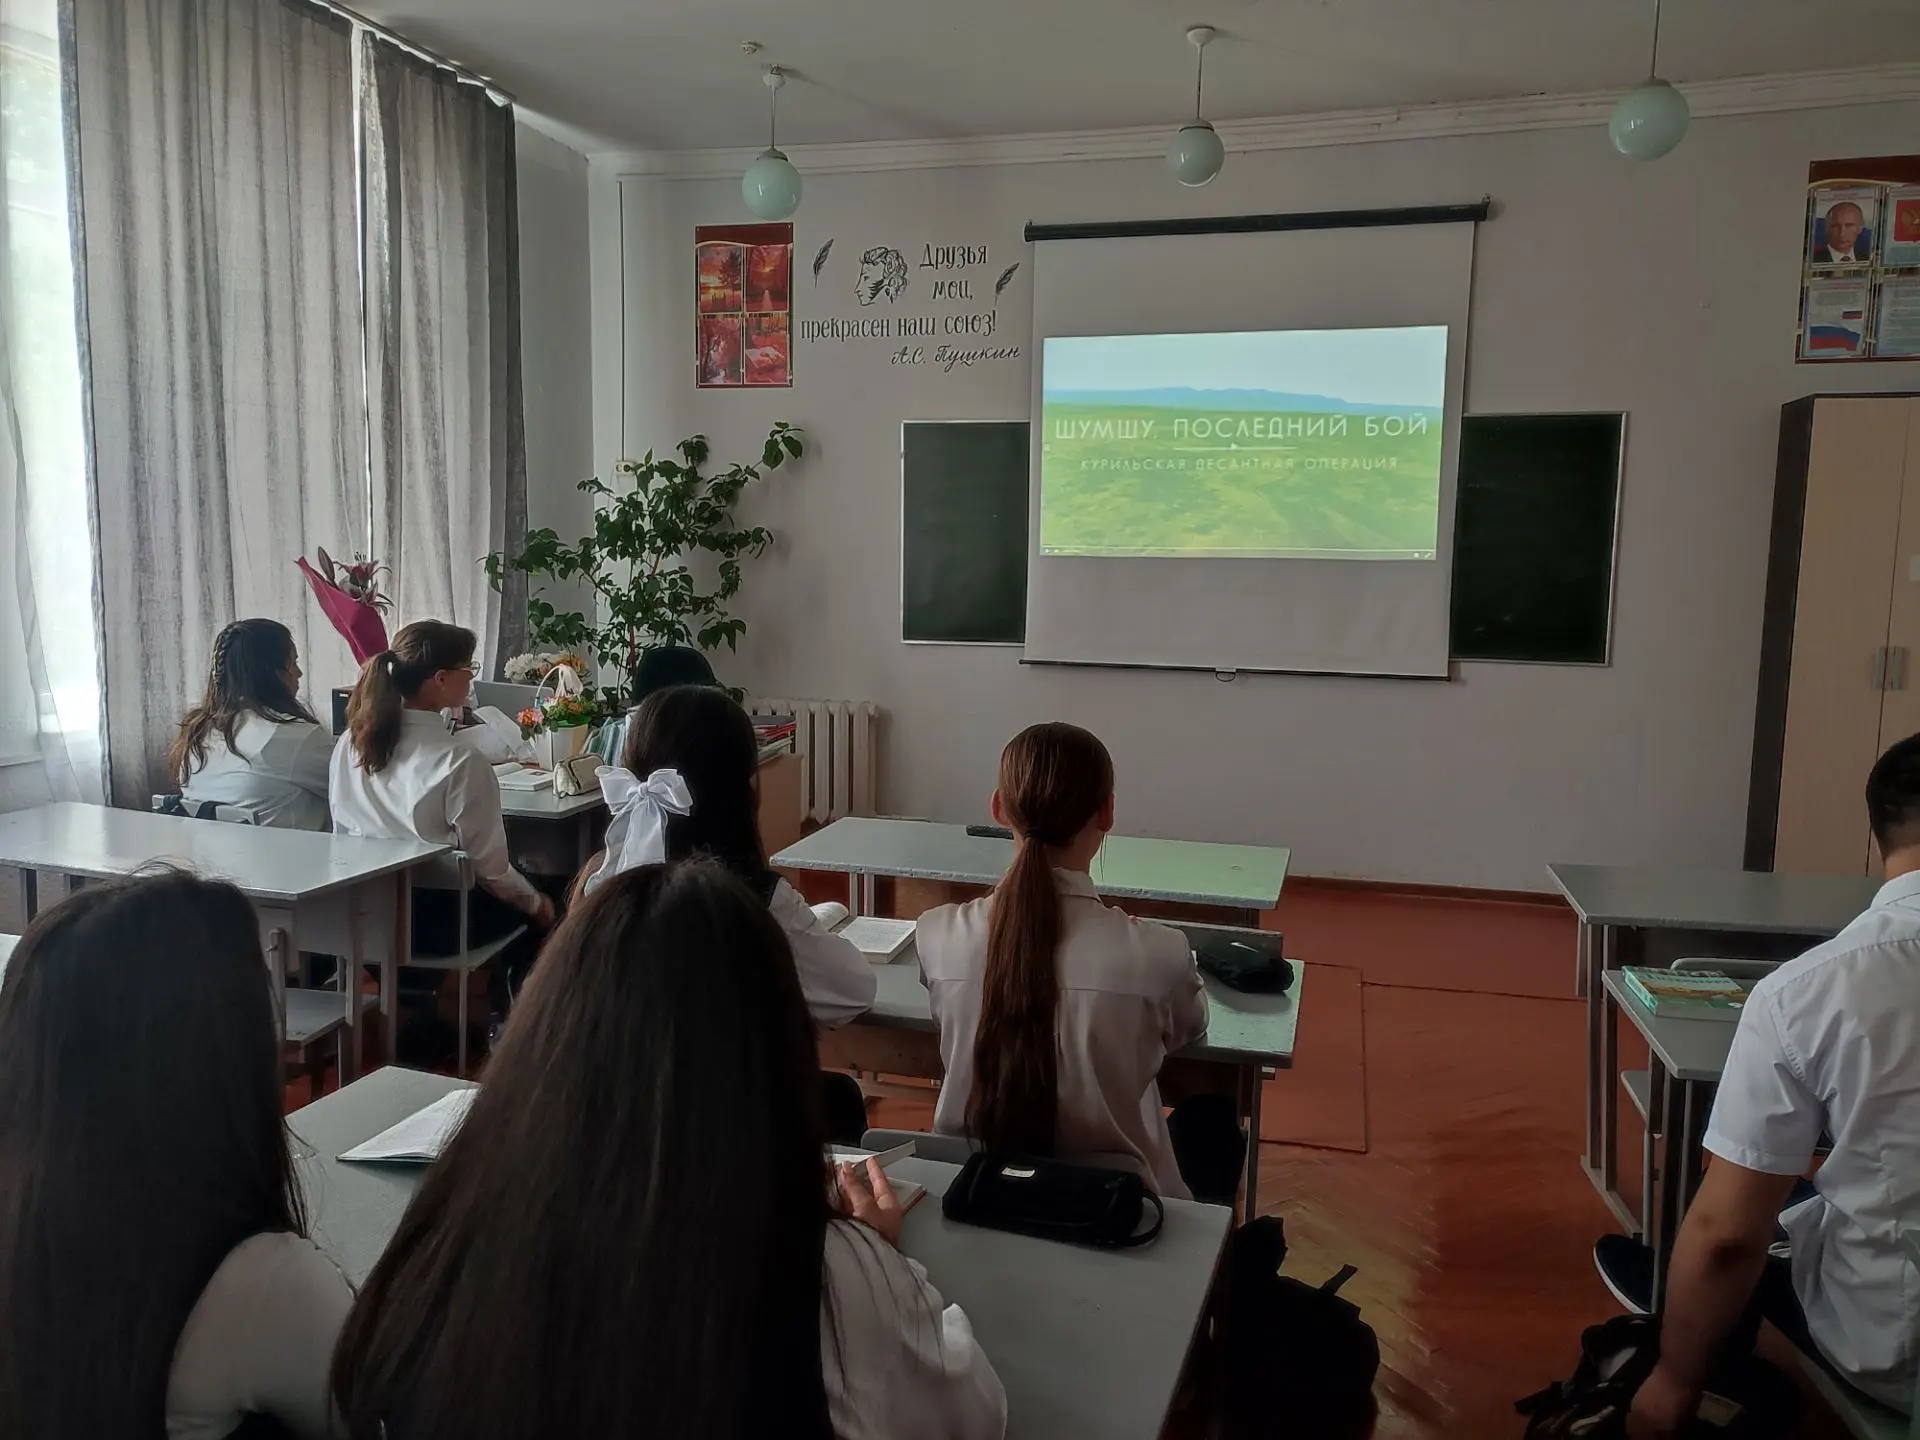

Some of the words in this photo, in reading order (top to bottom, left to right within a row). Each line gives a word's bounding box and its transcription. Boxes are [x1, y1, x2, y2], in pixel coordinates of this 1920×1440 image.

[919, 243, 988, 270] Друзья
[932, 280, 973, 301] мои,
[801, 318, 890, 342] прекрасен
[897, 317, 936, 336] наш
[944, 310, 996, 336] союз!
[891, 345, 926, 365] А.С.
[934, 344, 1021, 373] Пушкин
[1055, 419, 1158, 439] ШУМШУ.
[1173, 414, 1348, 439] ПОСЛЕДНИЙ
[1364, 412, 1428, 437] БОЙ
[1080, 458, 1186, 471] КУРИЛЬСКАЯ
[1195, 458, 1295, 471] ДЕСАНТНАЯ
[1304, 457, 1399, 470] ОПЕРАЦИЯ
